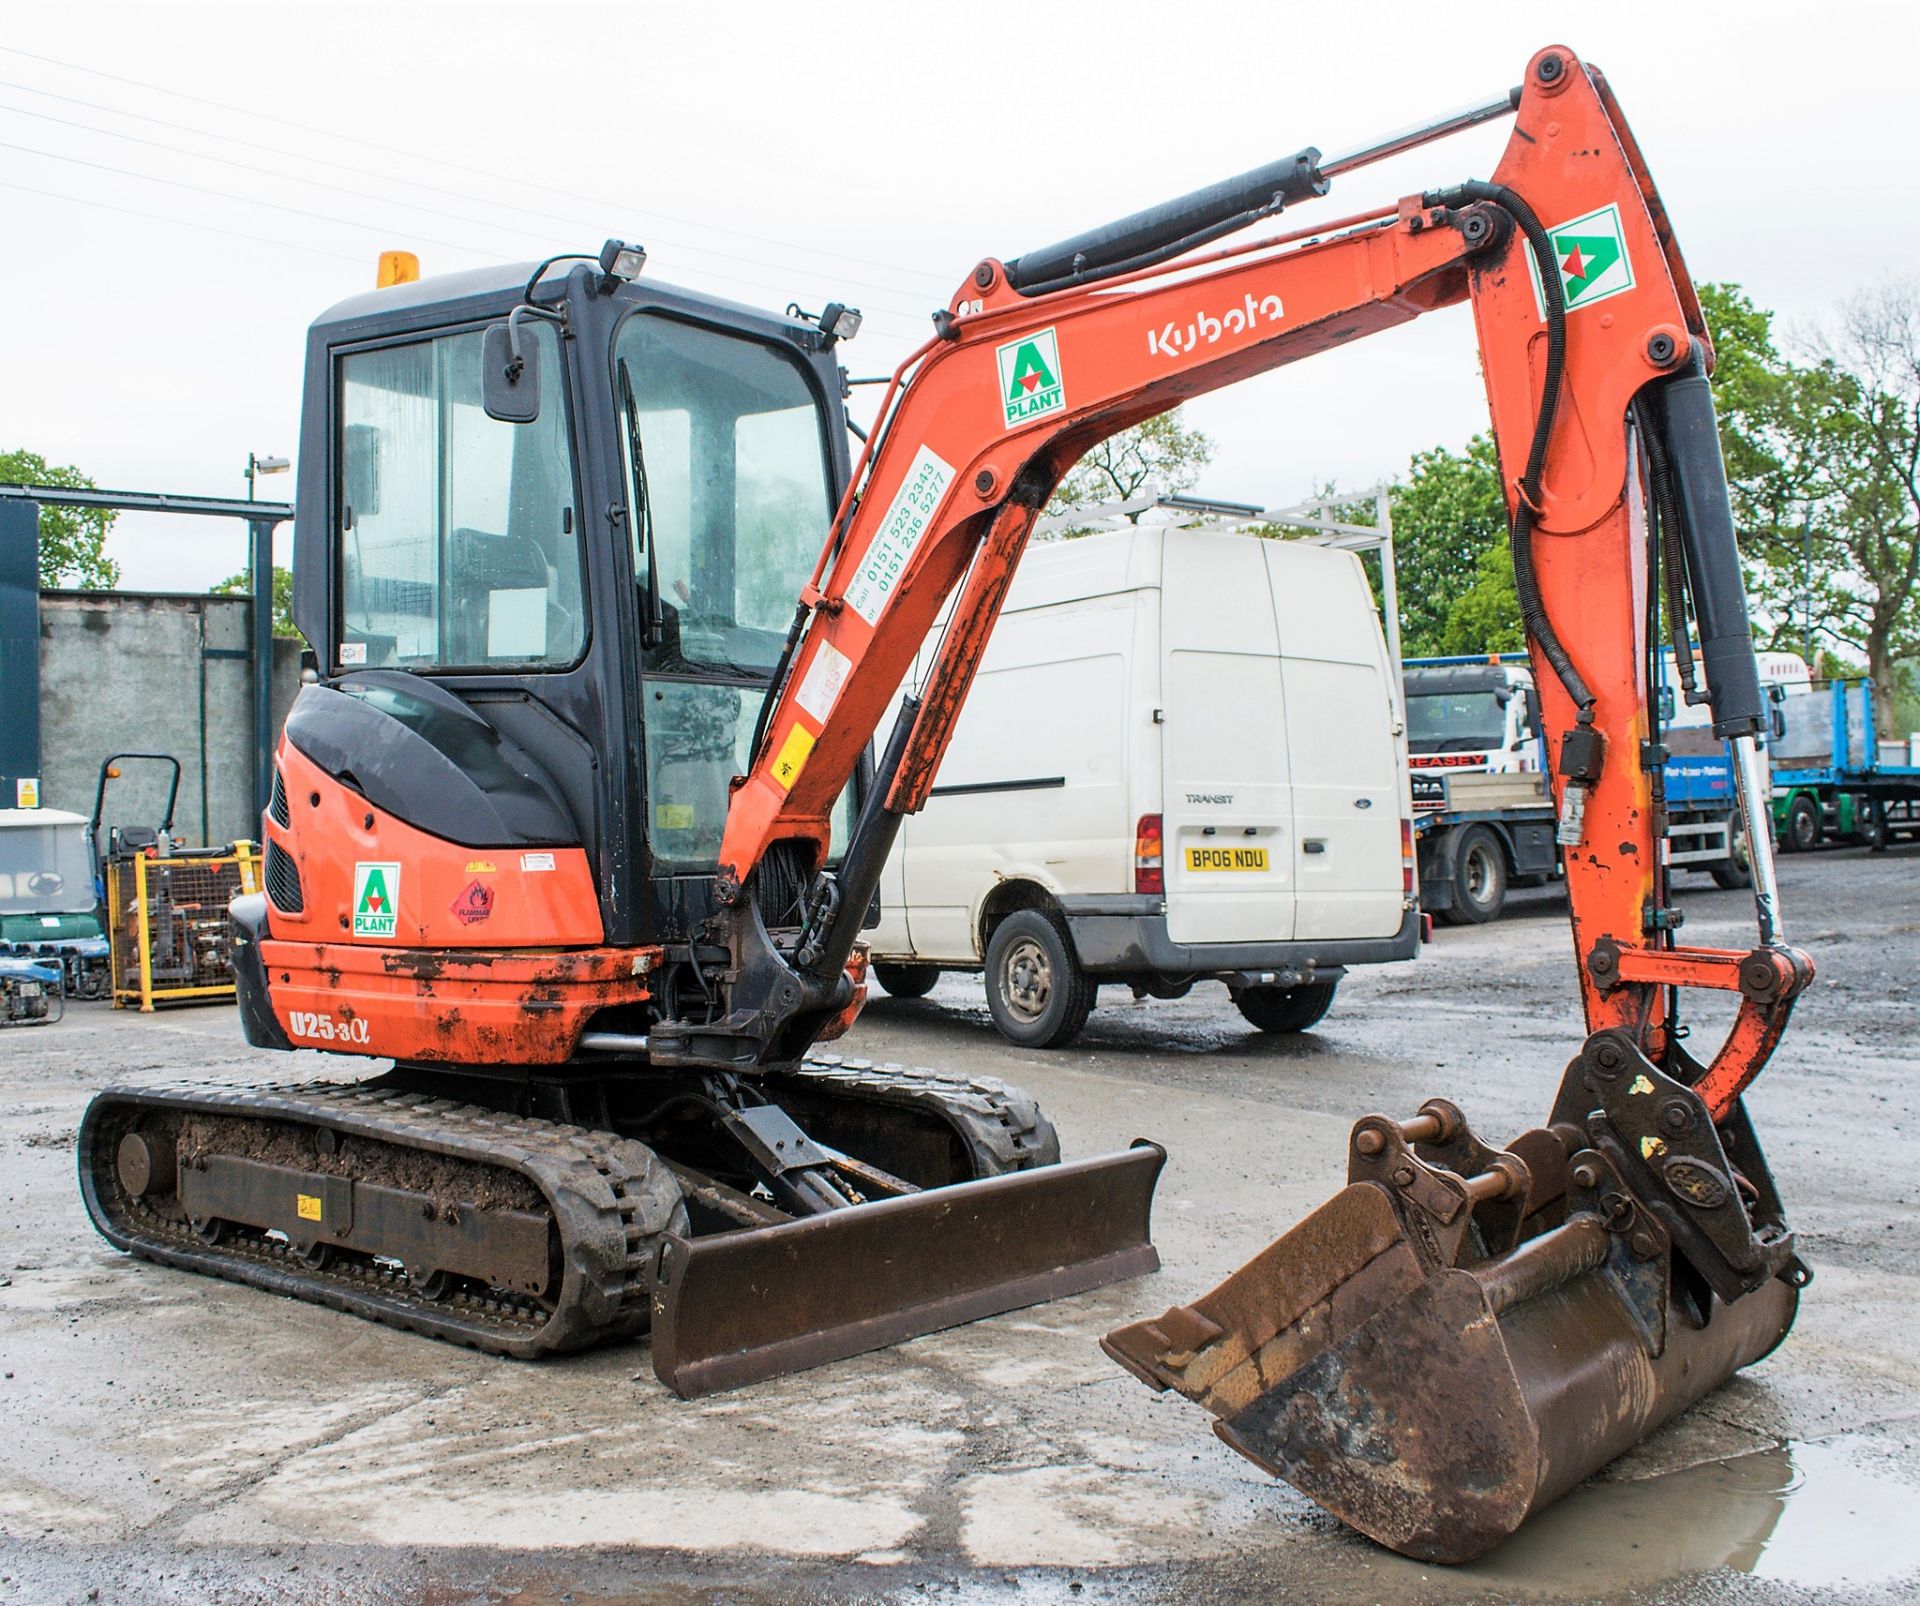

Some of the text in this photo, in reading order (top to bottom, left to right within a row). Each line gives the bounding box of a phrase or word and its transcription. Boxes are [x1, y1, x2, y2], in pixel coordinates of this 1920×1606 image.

[1555, 235, 1620, 303] A
[1148, 293, 1285, 357] Kubota
[1010, 341, 1057, 401] A
[1006, 389, 1062, 421] PLANT
[855, 462, 935, 610] Call 0151 523 2343
[867, 471, 946, 621] or 0151 236 5277
[1185, 794, 1233, 804] TRANSIT
[1192, 850, 1263, 867] BP06 NDU
[358, 869, 392, 914] A
[354, 917, 395, 932] PLANT
